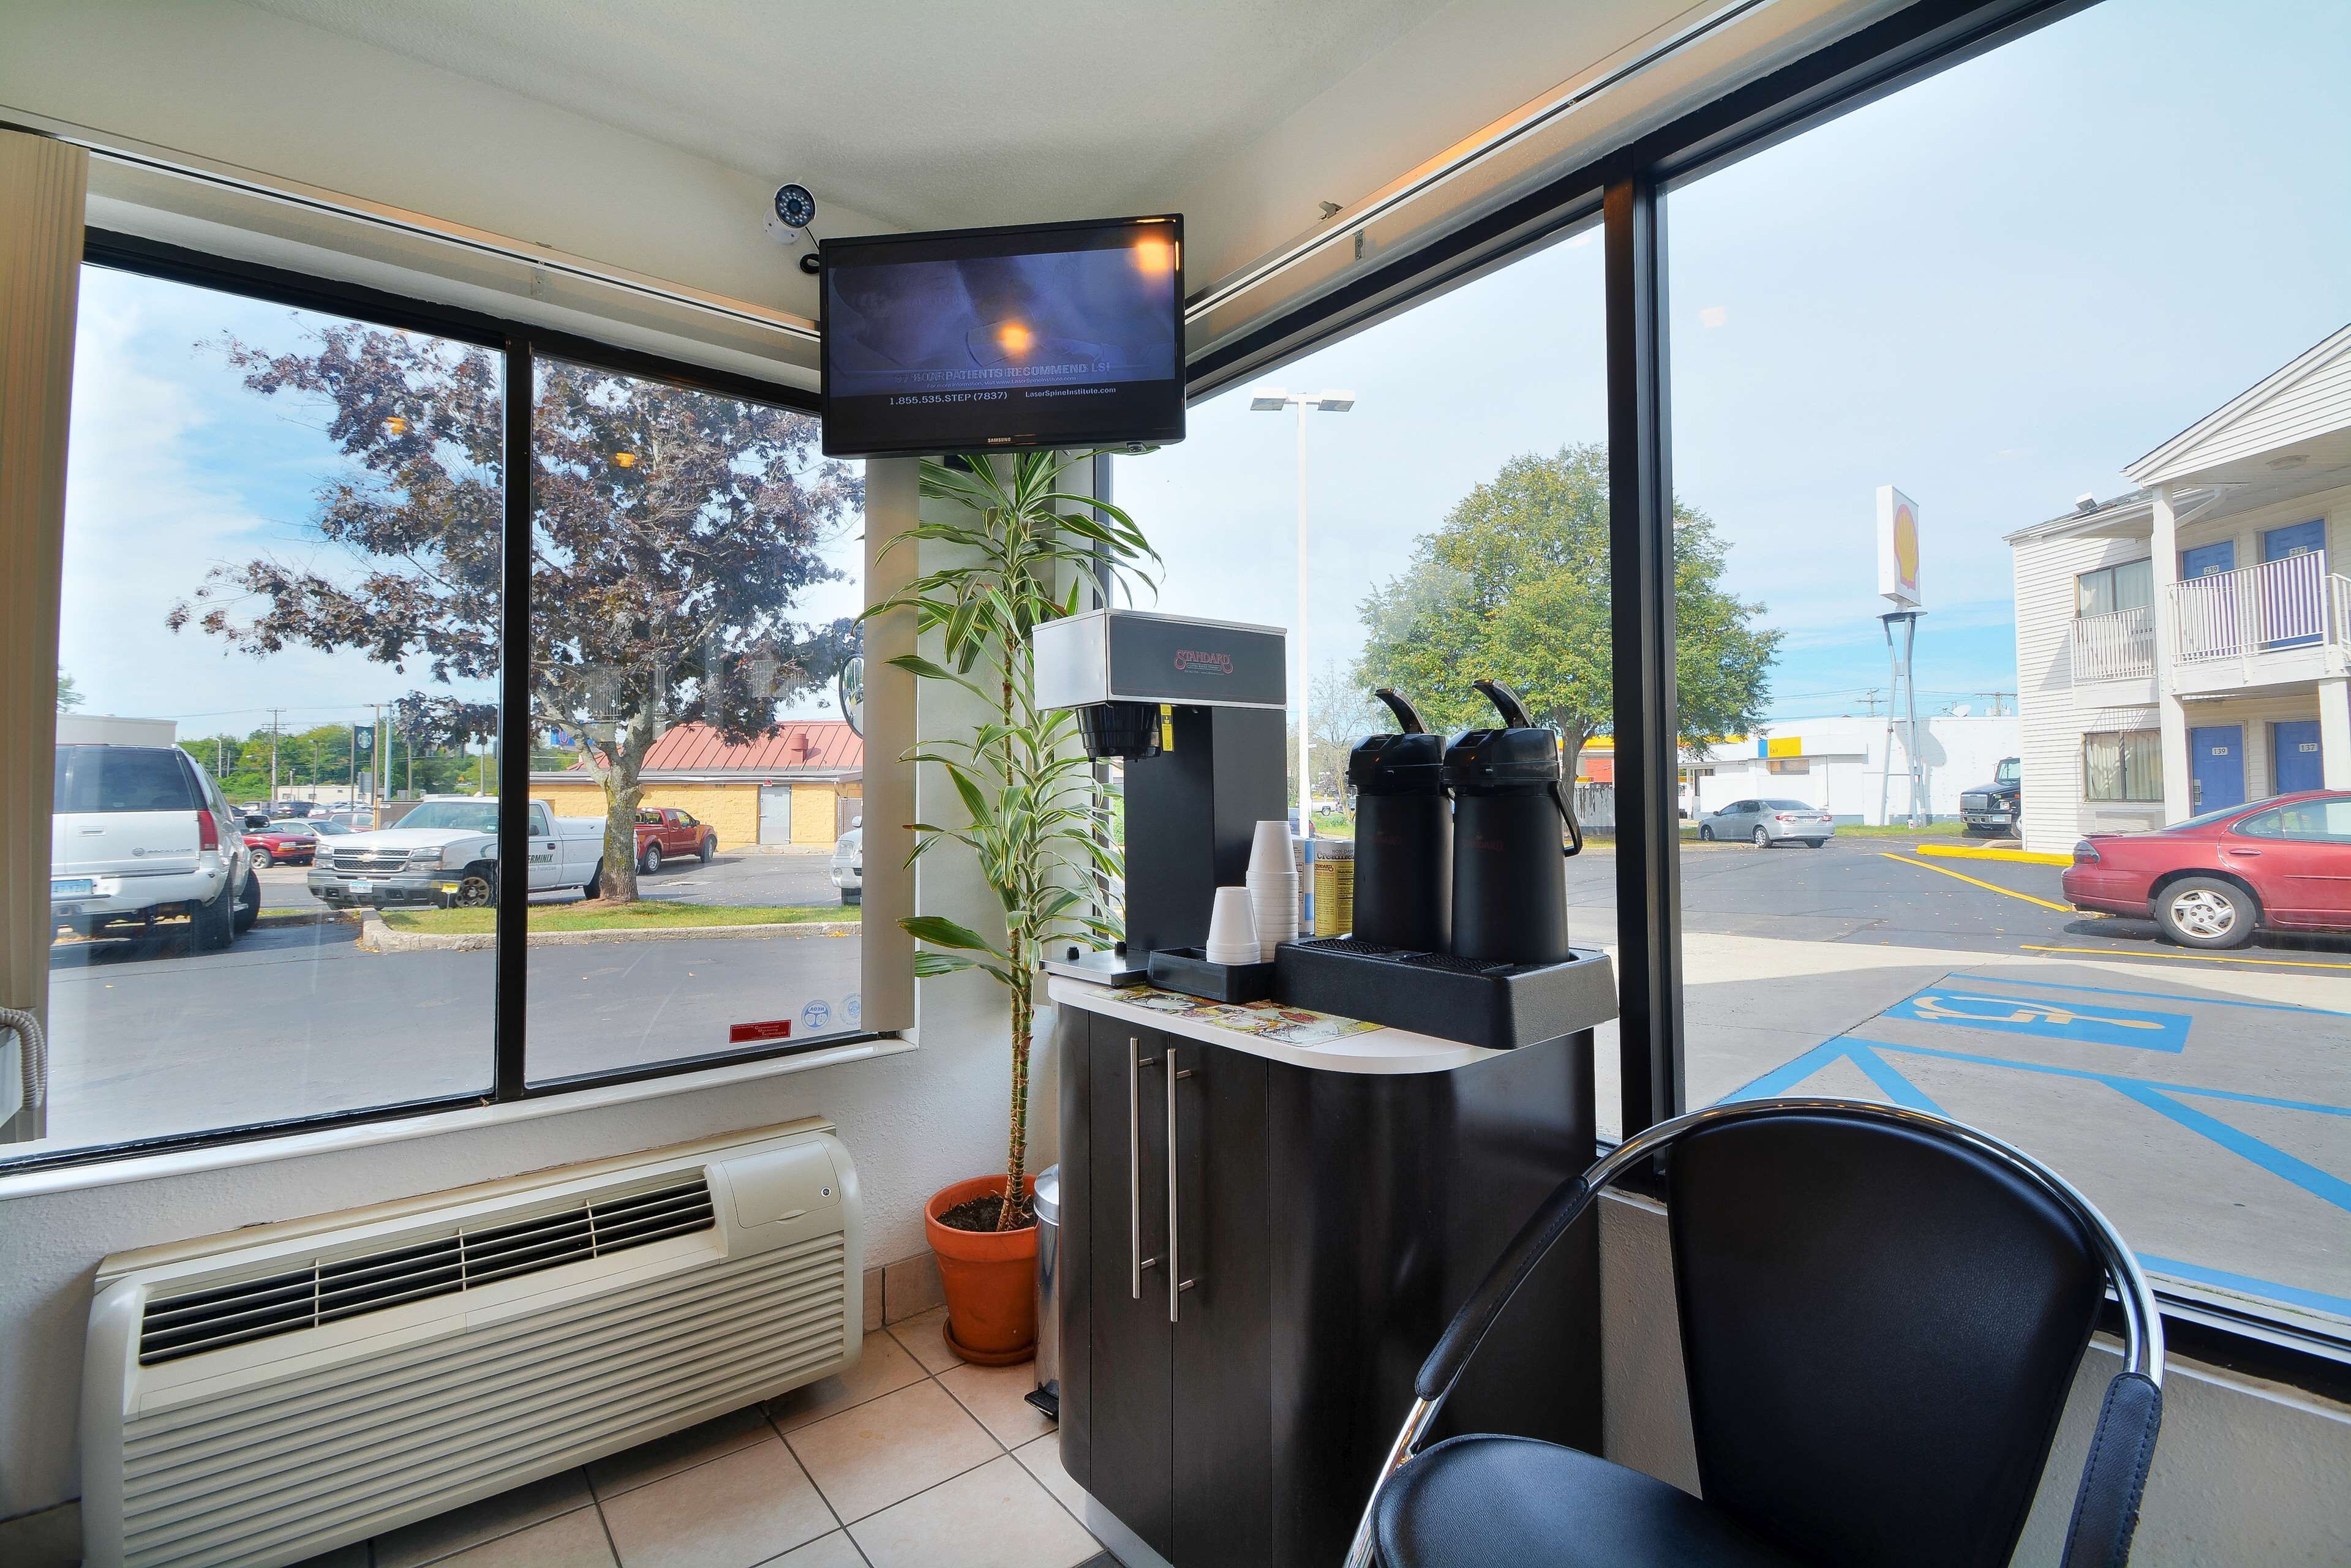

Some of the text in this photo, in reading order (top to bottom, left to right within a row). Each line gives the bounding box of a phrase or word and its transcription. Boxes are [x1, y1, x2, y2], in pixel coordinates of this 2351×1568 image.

[1091, 362, 1110, 373] LSI
[890, 393, 971, 405] 1.855.535.STEP
[973, 391, 1008, 402] (7837)
[2291, 547, 2306, 555] 237
[1175, 649, 1234, 674] STANDARD
